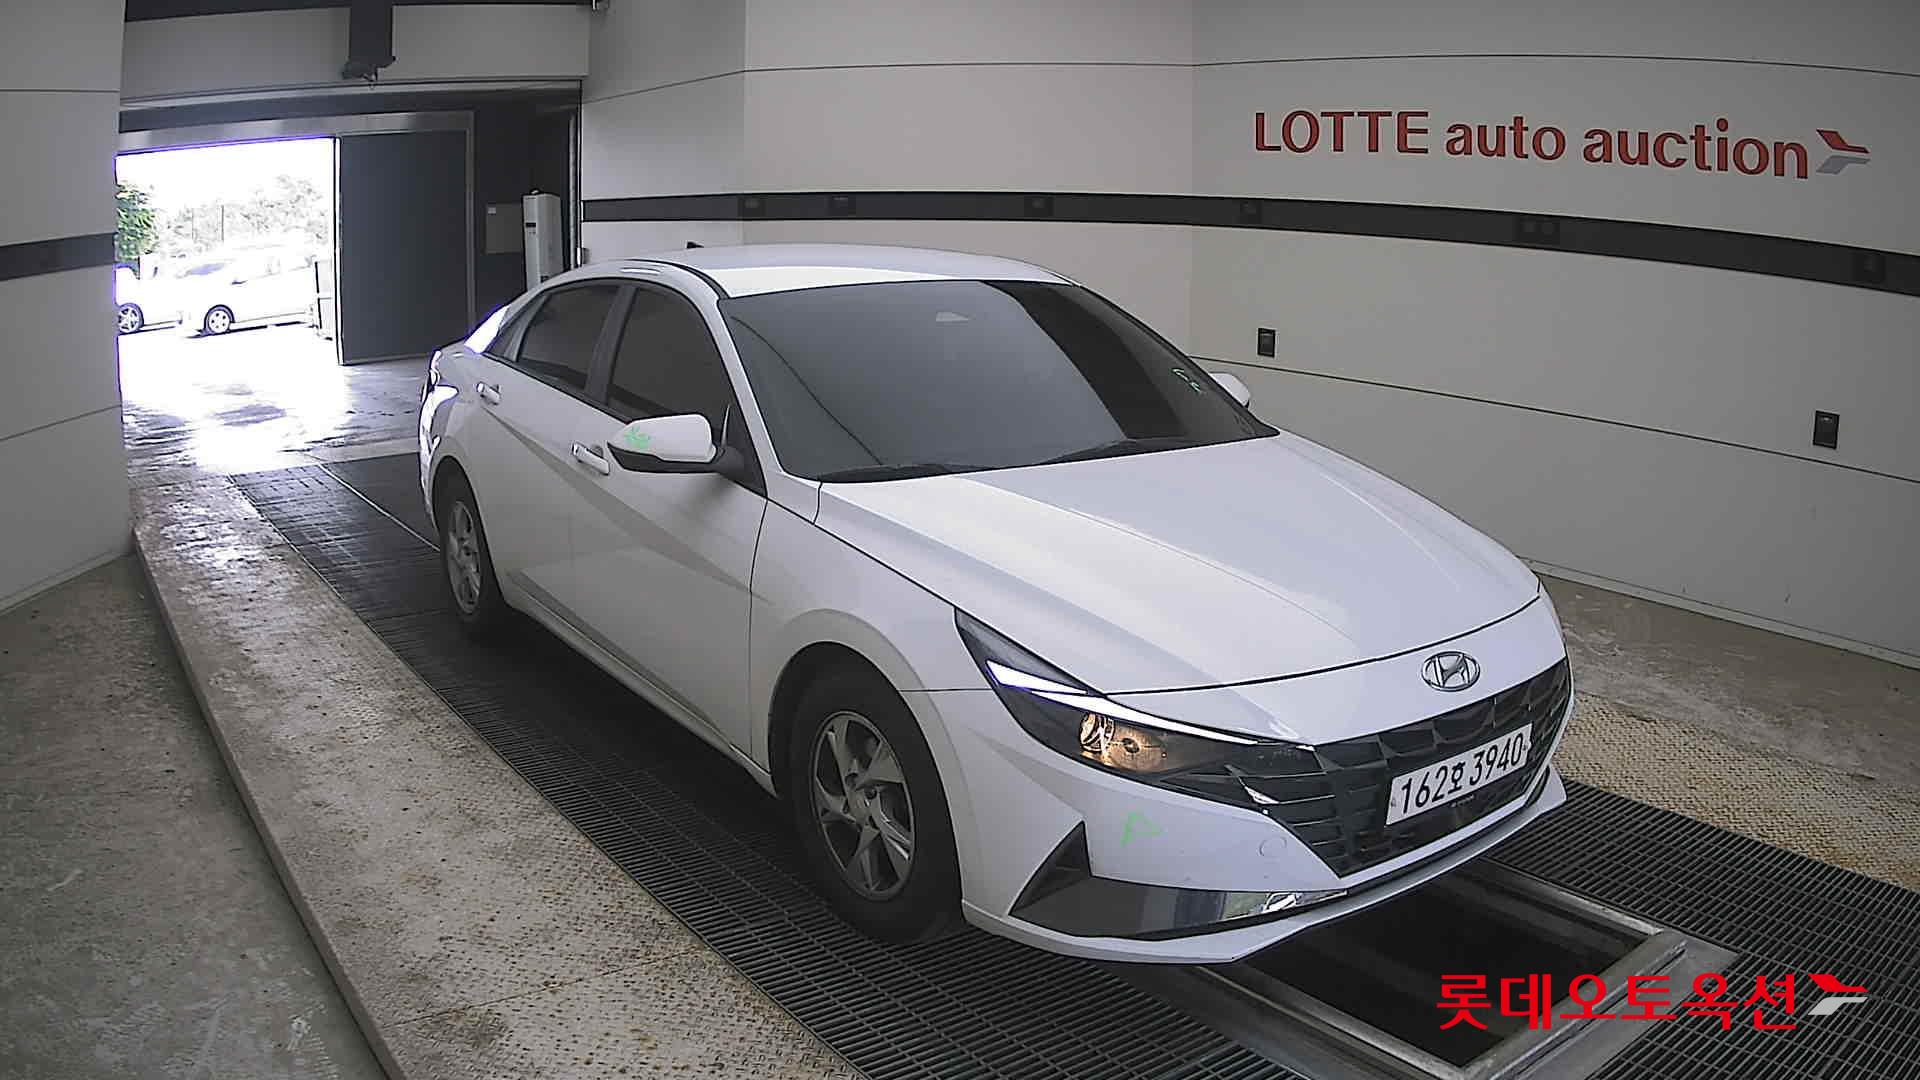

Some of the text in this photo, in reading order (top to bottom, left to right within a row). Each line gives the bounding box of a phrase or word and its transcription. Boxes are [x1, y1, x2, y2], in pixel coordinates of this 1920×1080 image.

[1254, 111, 1809, 180] LOTTE auto auction
[1470, 733, 1524, 786] 3940
